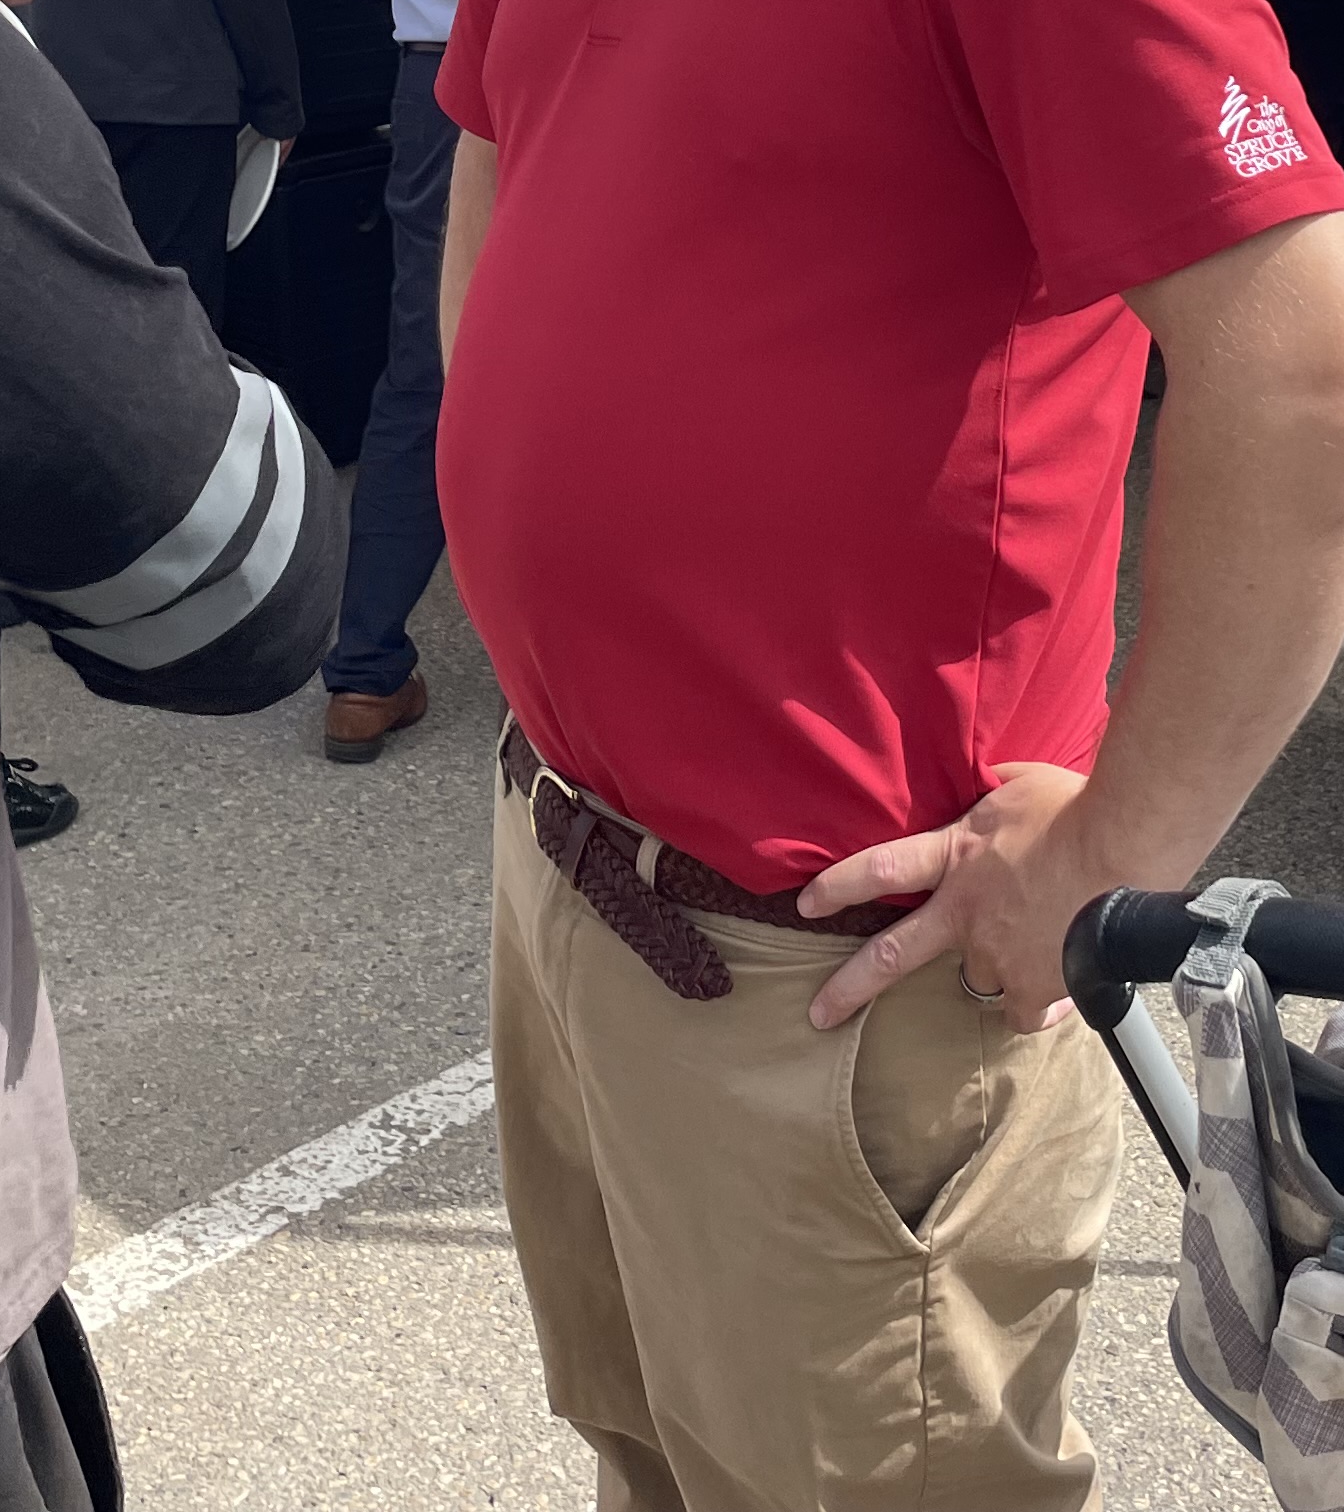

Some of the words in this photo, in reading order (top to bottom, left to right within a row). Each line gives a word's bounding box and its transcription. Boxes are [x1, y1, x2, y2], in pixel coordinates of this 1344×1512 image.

[1253, 94, 1279, 119] The
[1223, 128, 1299, 166] SPRUCE
[1235, 144, 1309, 178] GROVE
